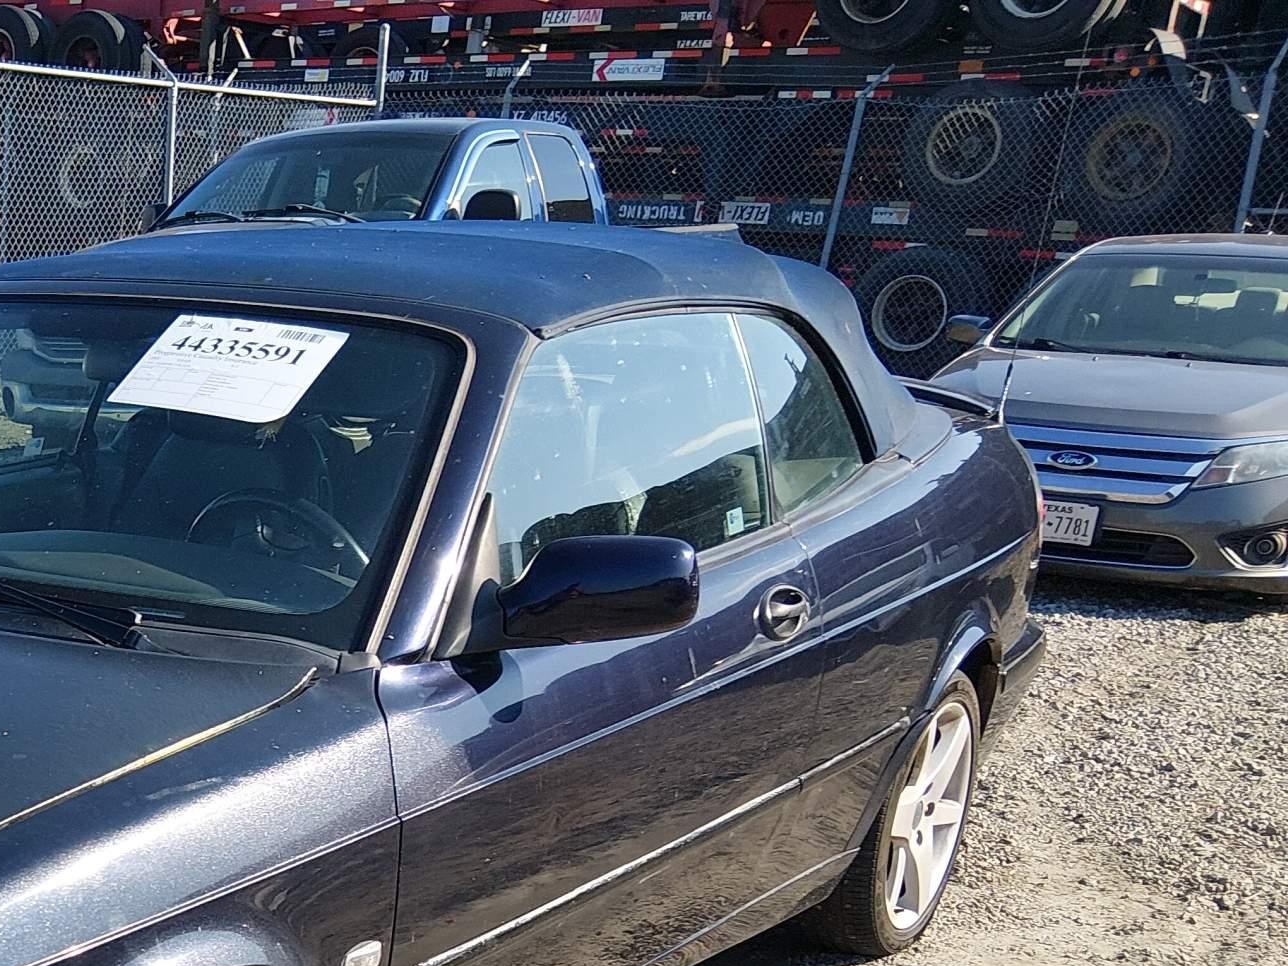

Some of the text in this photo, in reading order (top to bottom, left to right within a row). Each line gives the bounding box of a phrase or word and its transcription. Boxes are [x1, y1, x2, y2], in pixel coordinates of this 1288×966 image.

[544, 10, 601, 25] FLEXI-VAN
[618, 204, 686, 222] TRUCKING
[171, 334, 307, 366] 44335591
[1058, 453, 1085, 465] Ford
[1054, 516, 1090, 537] 7781
